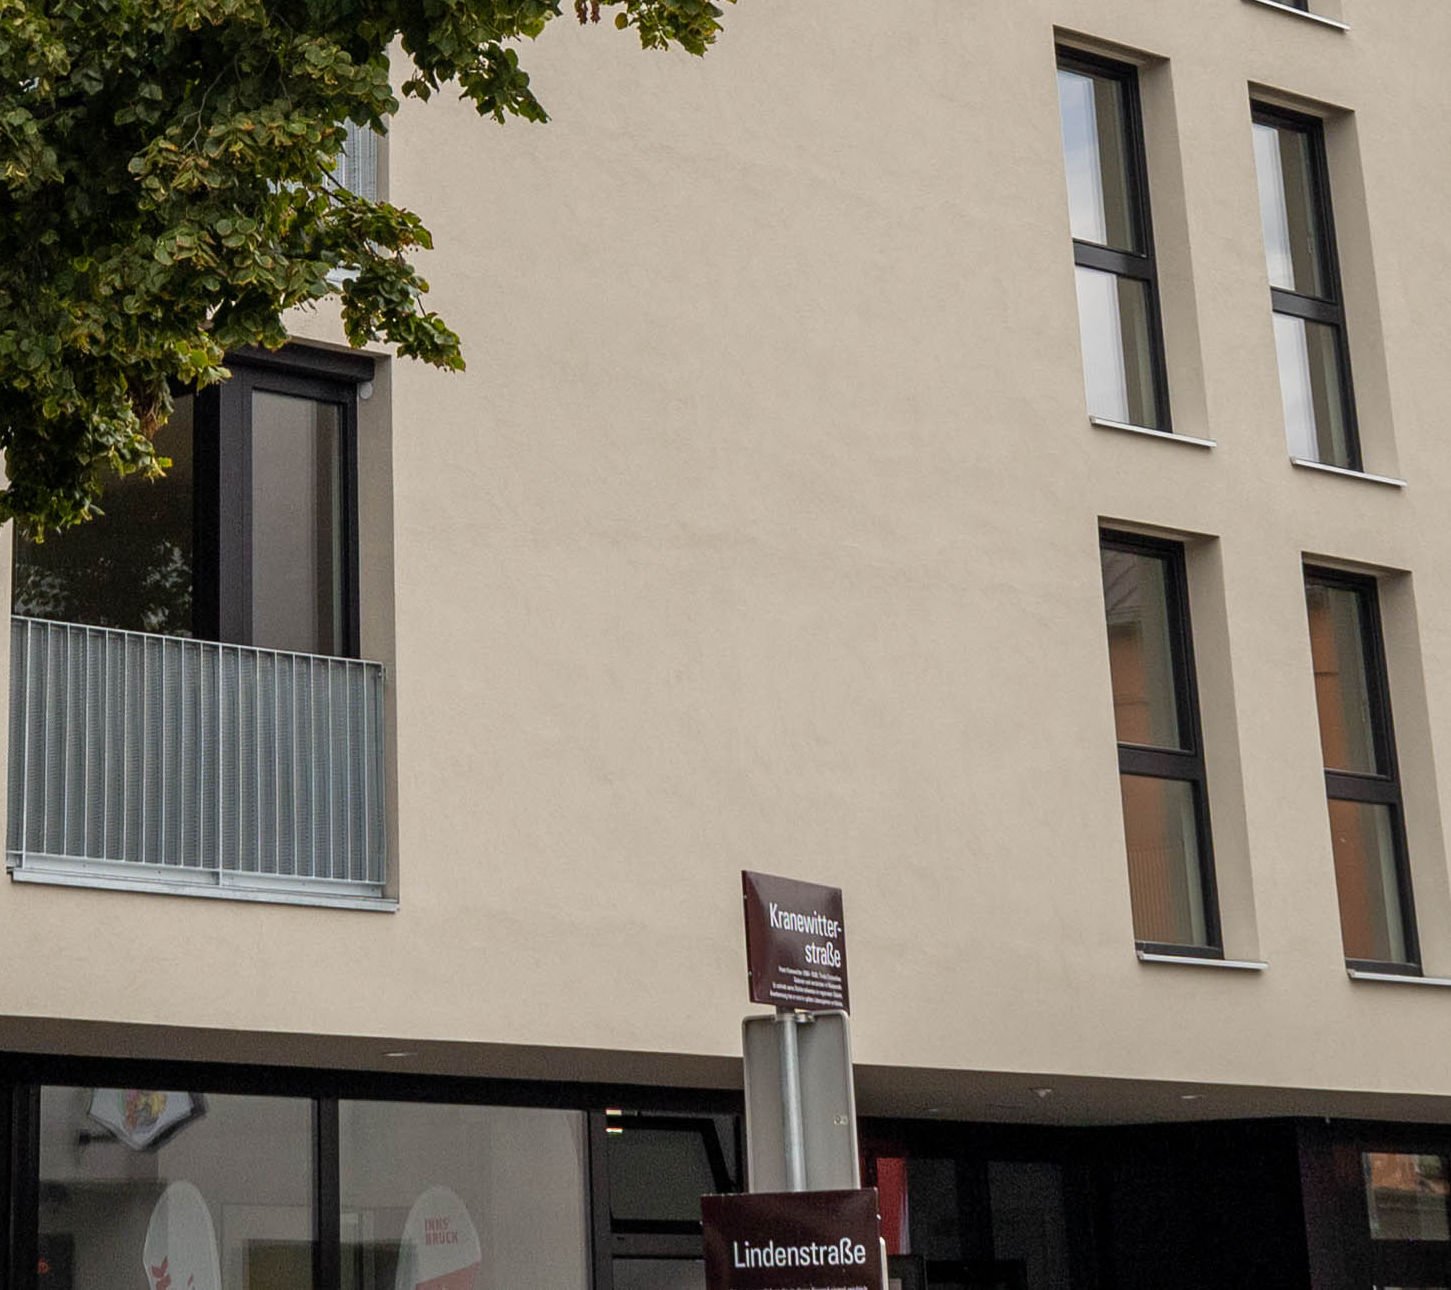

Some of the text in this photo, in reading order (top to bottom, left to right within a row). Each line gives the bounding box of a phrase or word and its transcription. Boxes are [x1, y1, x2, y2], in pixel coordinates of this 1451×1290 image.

[769, 901, 842, 938] Kranewitter-
[804, 941, 842, 968] straße
[733, 1237, 867, 1269] Lindenstraße
